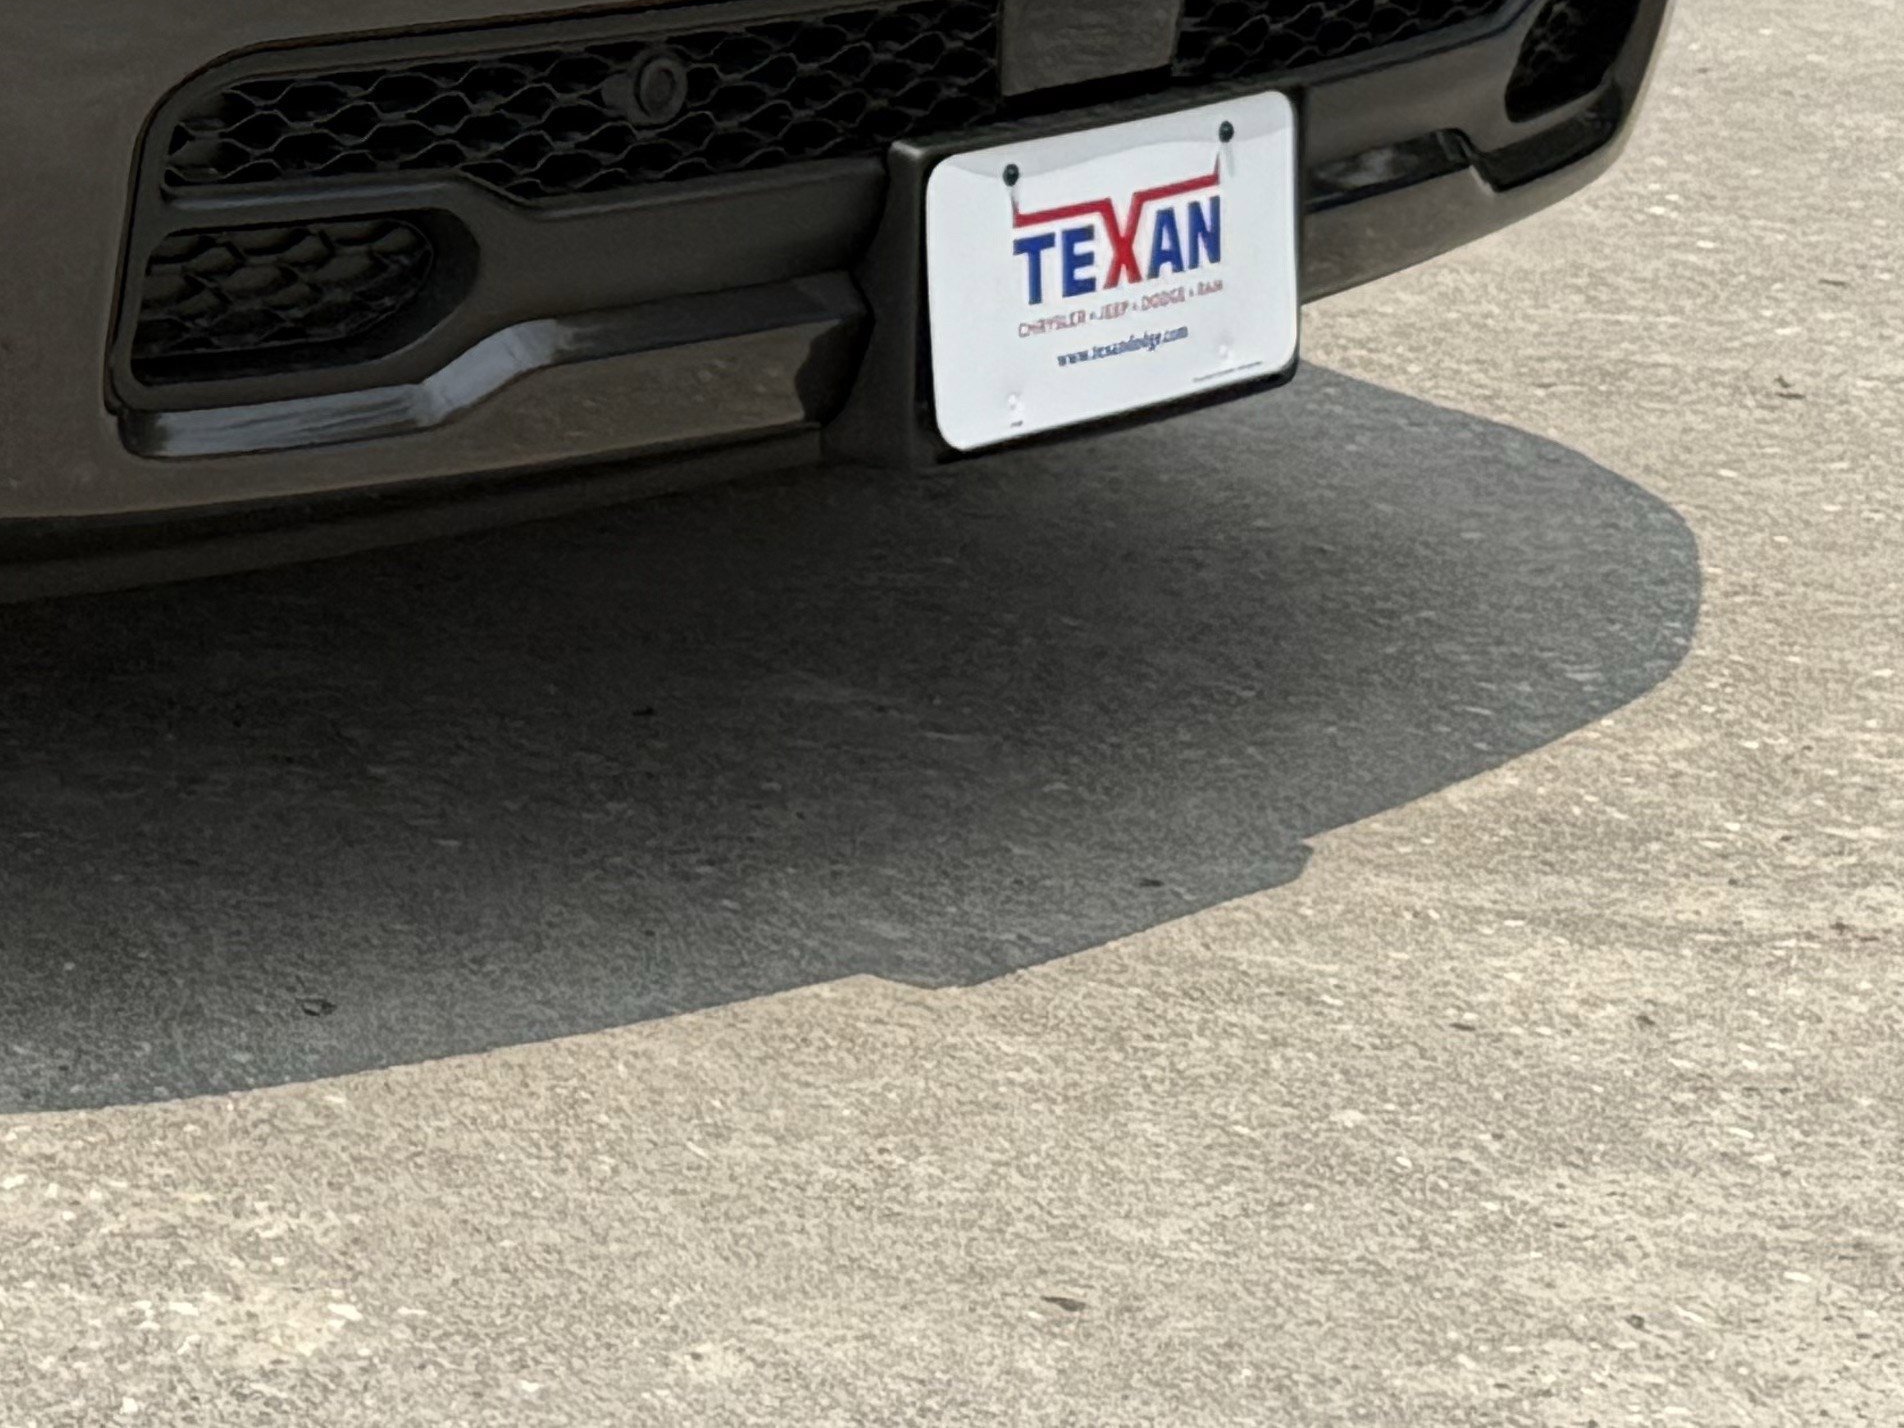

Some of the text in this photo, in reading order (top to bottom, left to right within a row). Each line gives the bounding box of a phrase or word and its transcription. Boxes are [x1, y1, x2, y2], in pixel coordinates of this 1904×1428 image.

[1012, 192, 1222, 306] TEXAN
[1018, 309, 1086, 338] CHRYSLER
[1099, 300, 1129, 321] JEEP
[1141, 286, 1186, 311] DODGE
